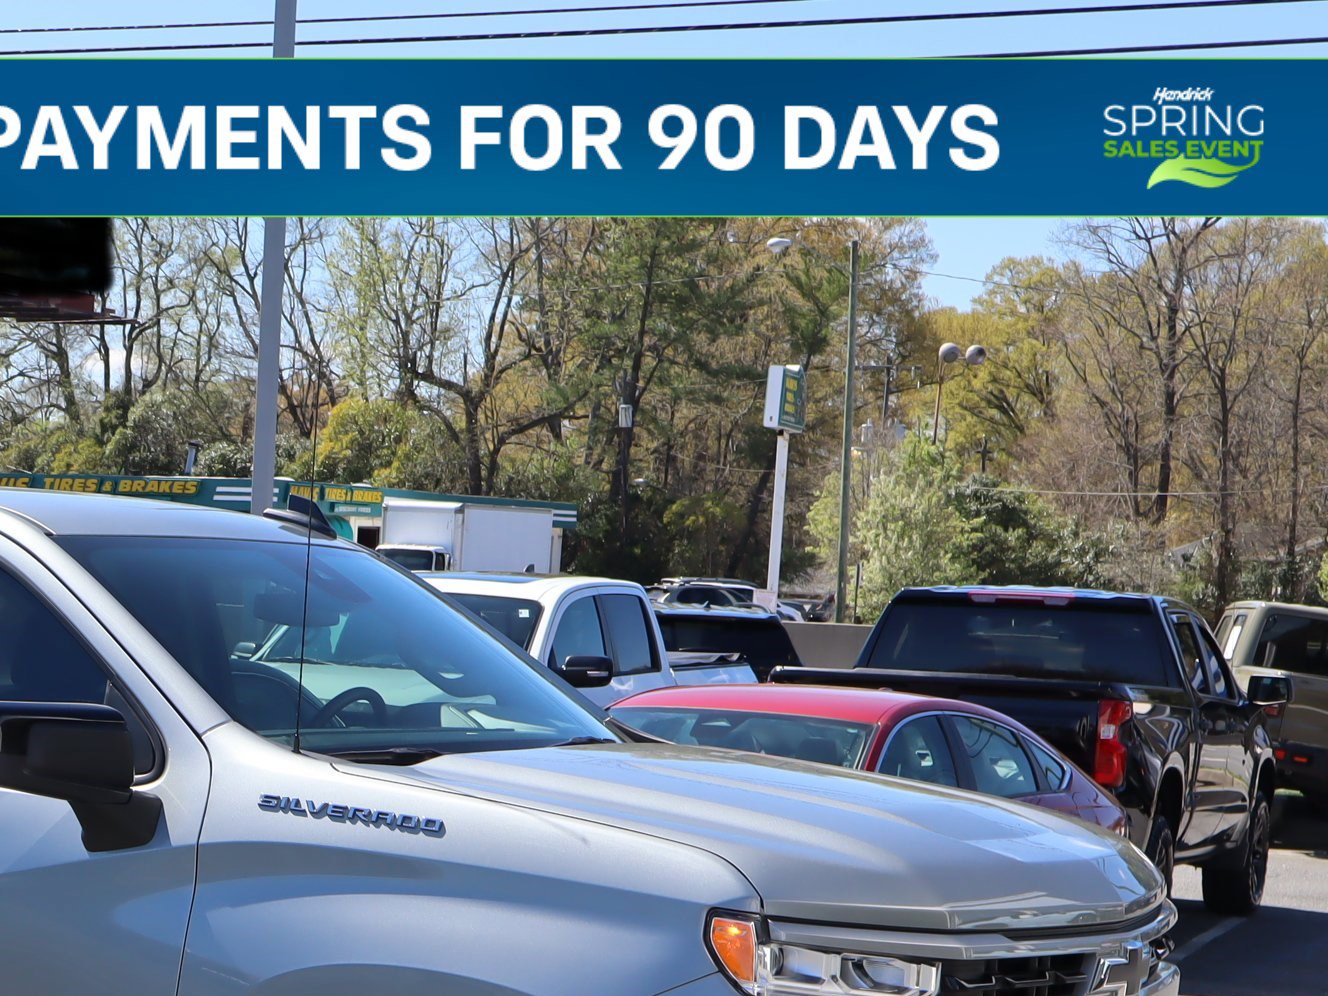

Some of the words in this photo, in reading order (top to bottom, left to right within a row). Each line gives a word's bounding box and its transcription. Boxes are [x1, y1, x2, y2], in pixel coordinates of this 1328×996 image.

[43, 477, 99, 492] TIRES
[101, 480, 116, 492] &
[118, 479, 200, 494] BRAKES
[290, 485, 320, 502] MAVS
[325, 487, 347, 501] TIRES
[353, 489, 383, 504] BRAKES
[257, 792, 447, 838] SILVERADO
